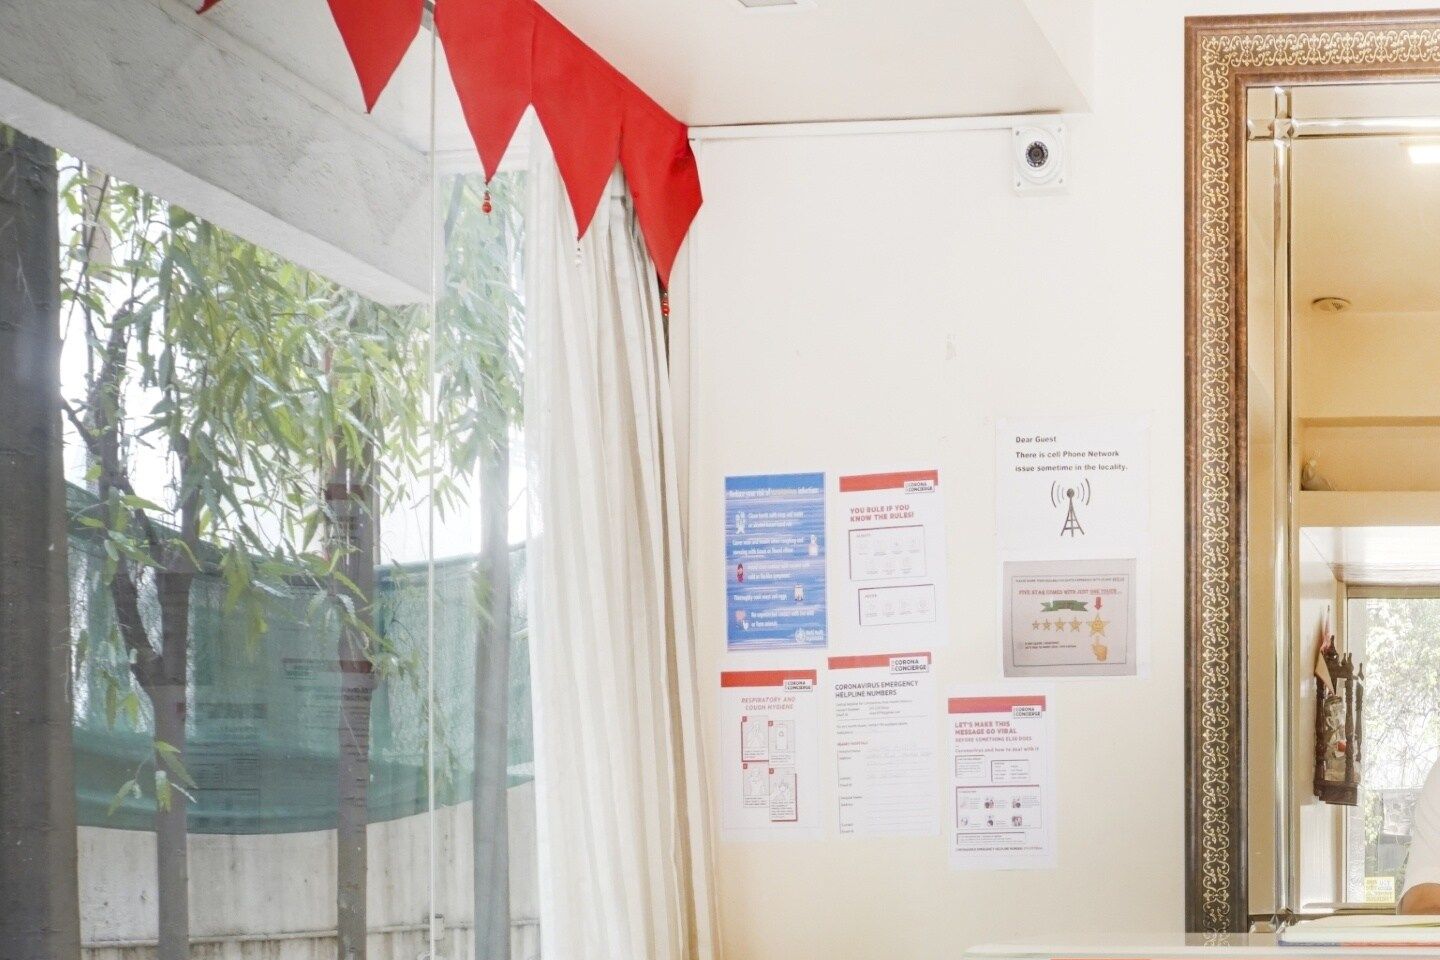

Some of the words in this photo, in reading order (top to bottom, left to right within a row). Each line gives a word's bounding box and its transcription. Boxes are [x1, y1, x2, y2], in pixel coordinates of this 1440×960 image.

[895, 664, 926, 672] CONCIERGE
[835, 682, 880, 690] CORONAVIRUS
[866, 689, 897, 697] NUMBERS
